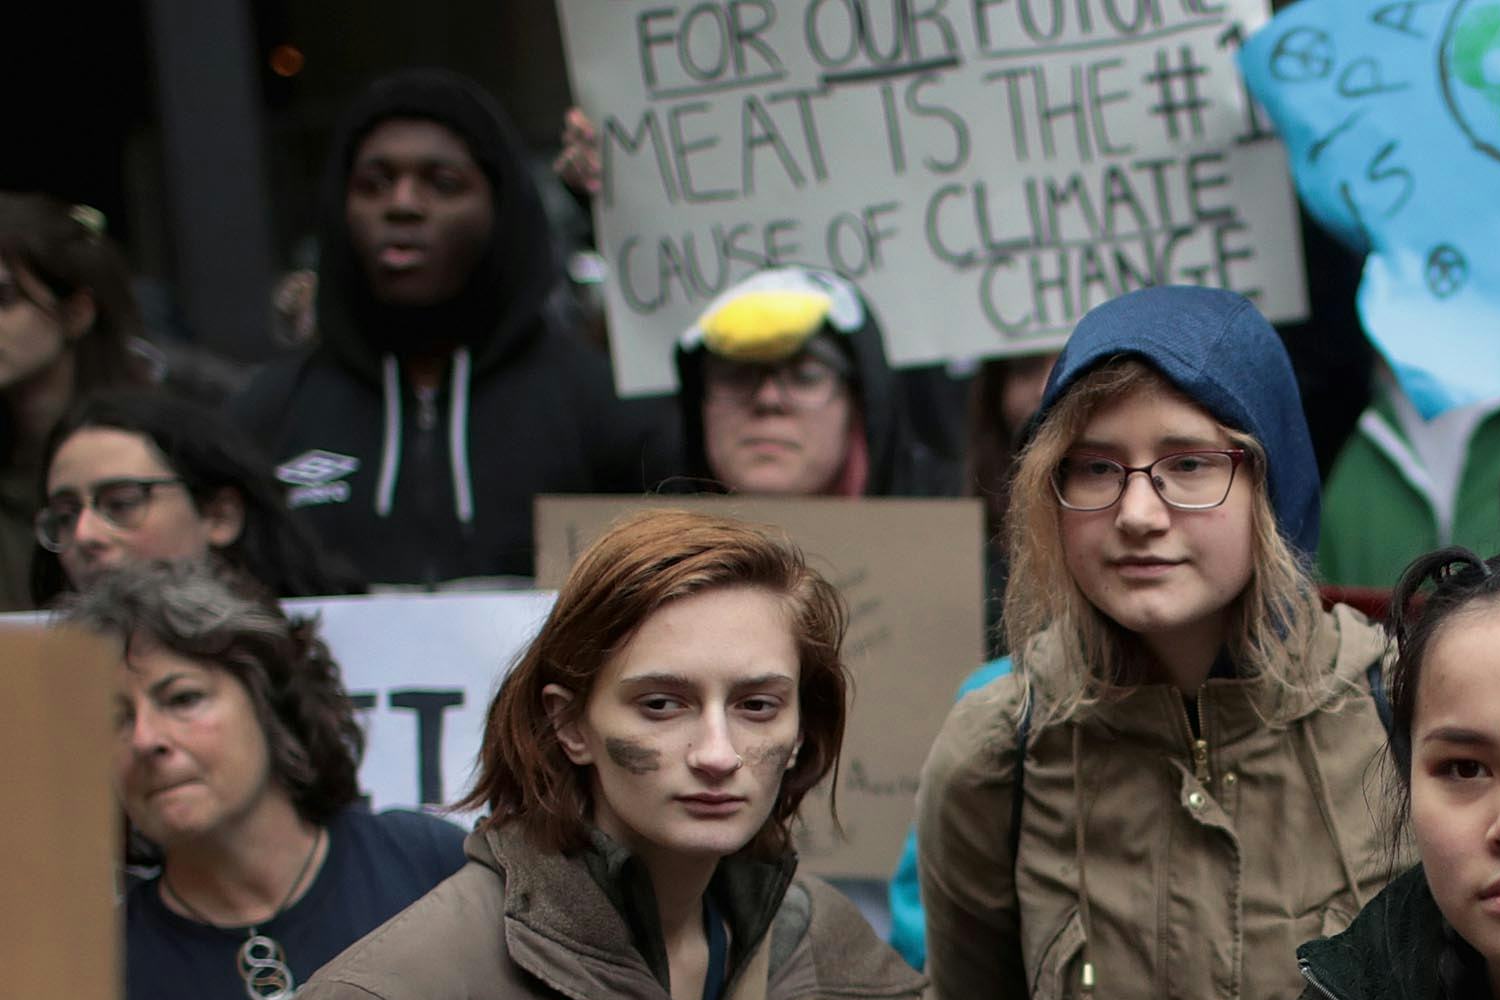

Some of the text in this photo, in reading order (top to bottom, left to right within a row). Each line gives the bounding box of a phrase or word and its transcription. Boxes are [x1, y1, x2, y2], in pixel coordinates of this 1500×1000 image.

[638, 0, 788, 87] FOR
[803, 0, 962, 67] OUR
[602, 88, 832, 203] MEAT
[881, 73, 971, 176] IS
[984, 60, 1136, 163] THE
[617, 153, 1237, 315] CAUSE OF CLIMATE
[980, 222, 1262, 335] CHANGE
